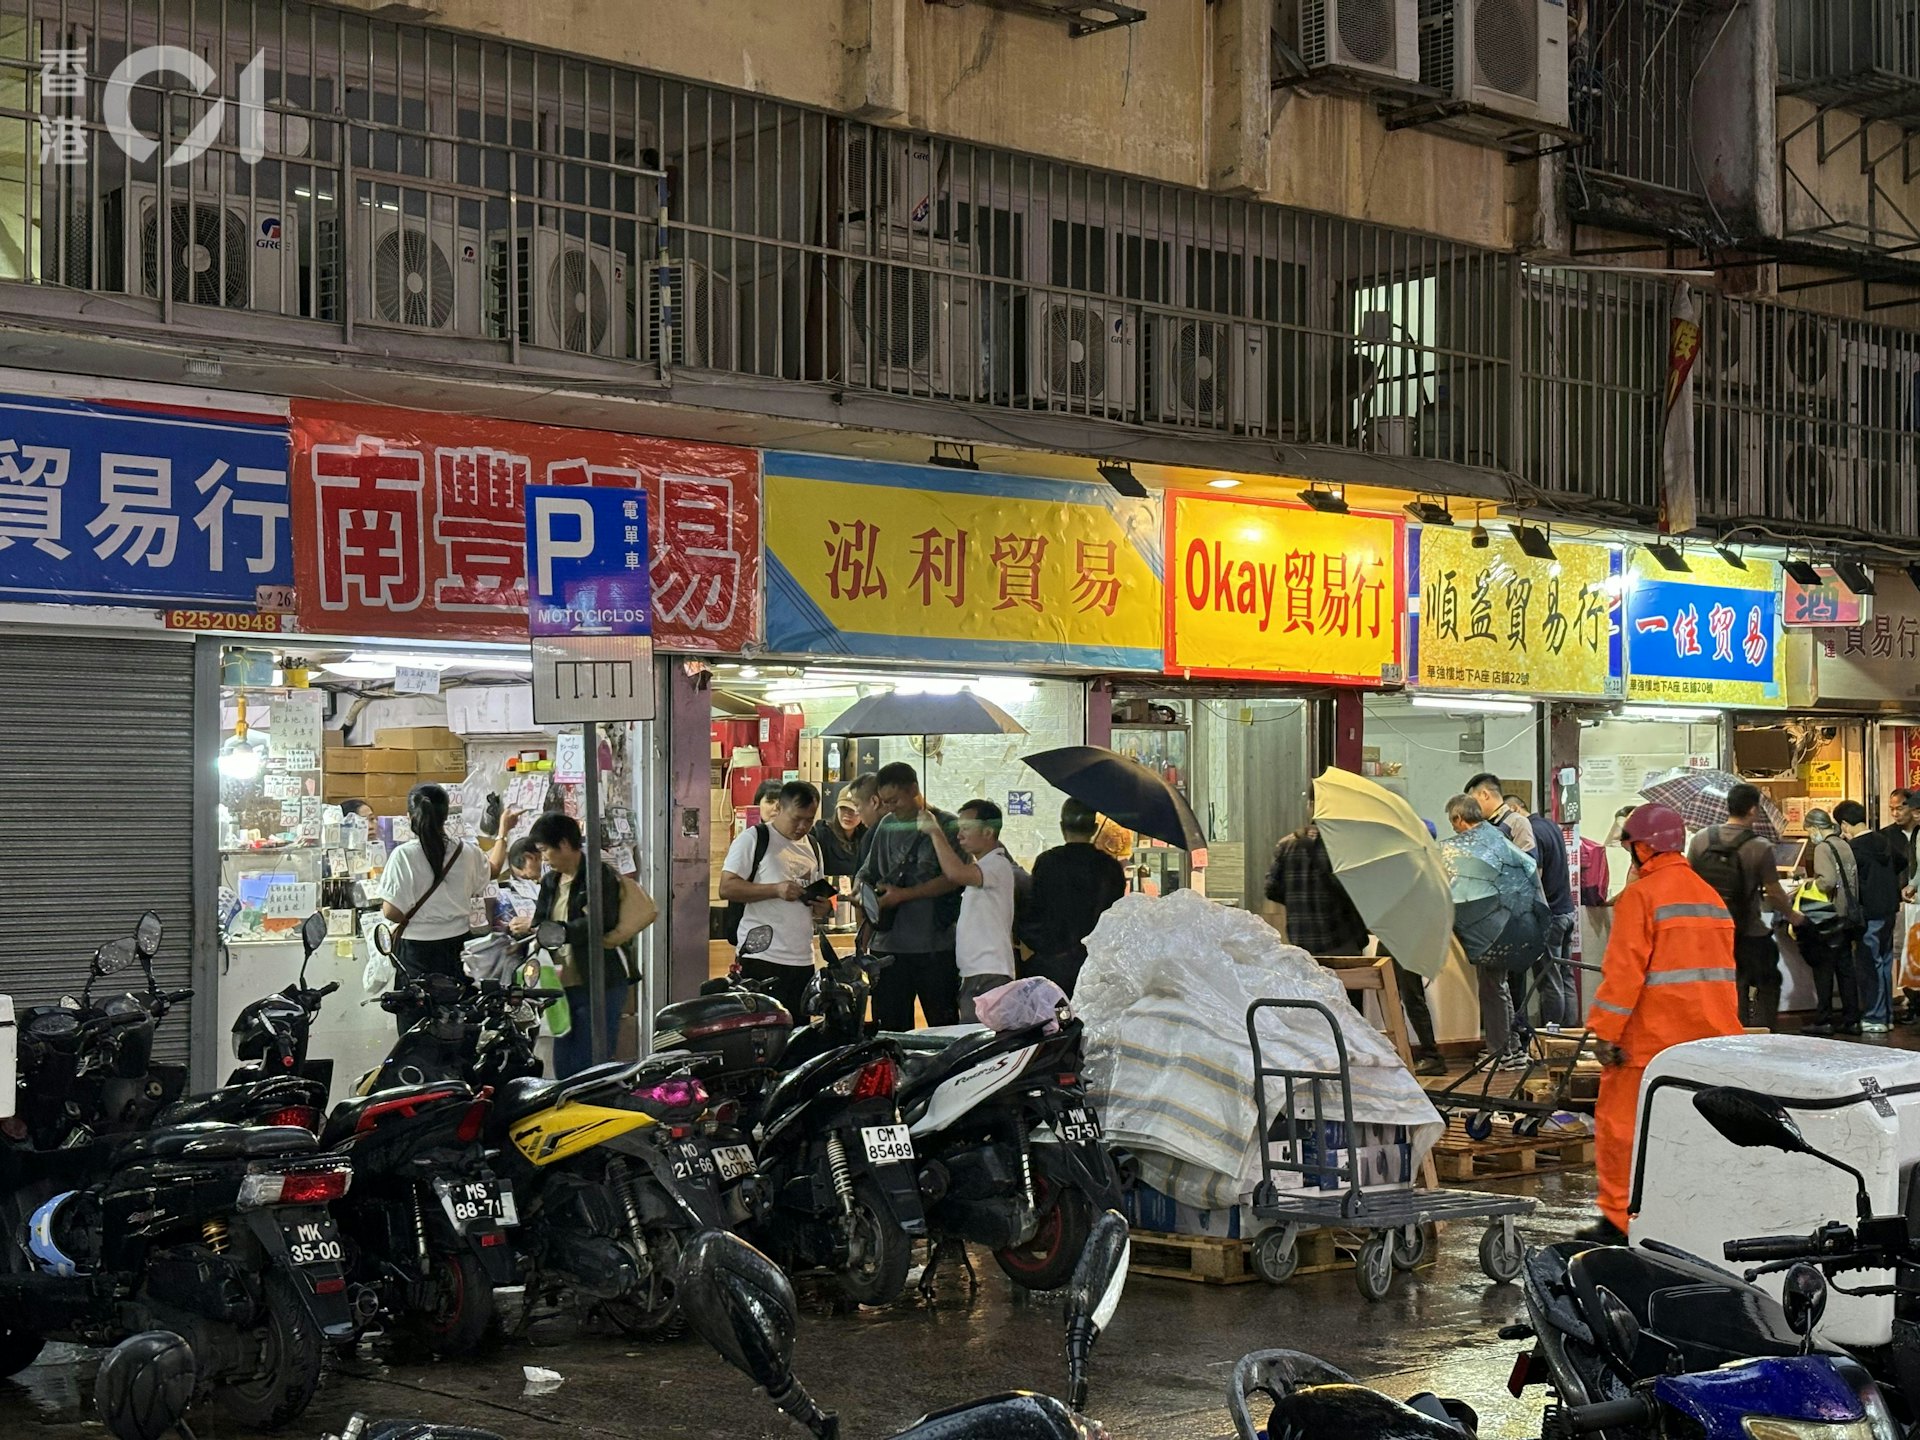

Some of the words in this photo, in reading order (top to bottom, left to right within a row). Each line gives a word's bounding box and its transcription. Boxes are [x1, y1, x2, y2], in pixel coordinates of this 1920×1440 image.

[0, 439, 290, 573] 貿易行
[312, 434, 742, 631] 南豐易
[623, 500, 640, 570] 電單車
[535, 497, 594, 595] P
[824, 519, 1122, 617] 泓利貿易
[277, 591, 291, 607] 26
[172, 610, 276, 632] 62520948
[538, 609, 645, 623] MOTOCICLOS
[877, 1127, 897, 1142] CM
[1065, 1122, 1100, 1141] 57-51
[679, 1143, 699, 1159] MO
[725, 1147, 744, 1160] CM
[869, 1142, 912, 1159] 85489
[674, 1156, 715, 1179] 21-66
[466, 1183, 487, 1200] MS
[456, 1199, 501, 1219] 88-71
[297, 1223, 321, 1243] MK
[291, 1240, 341, 1262] 35-00
